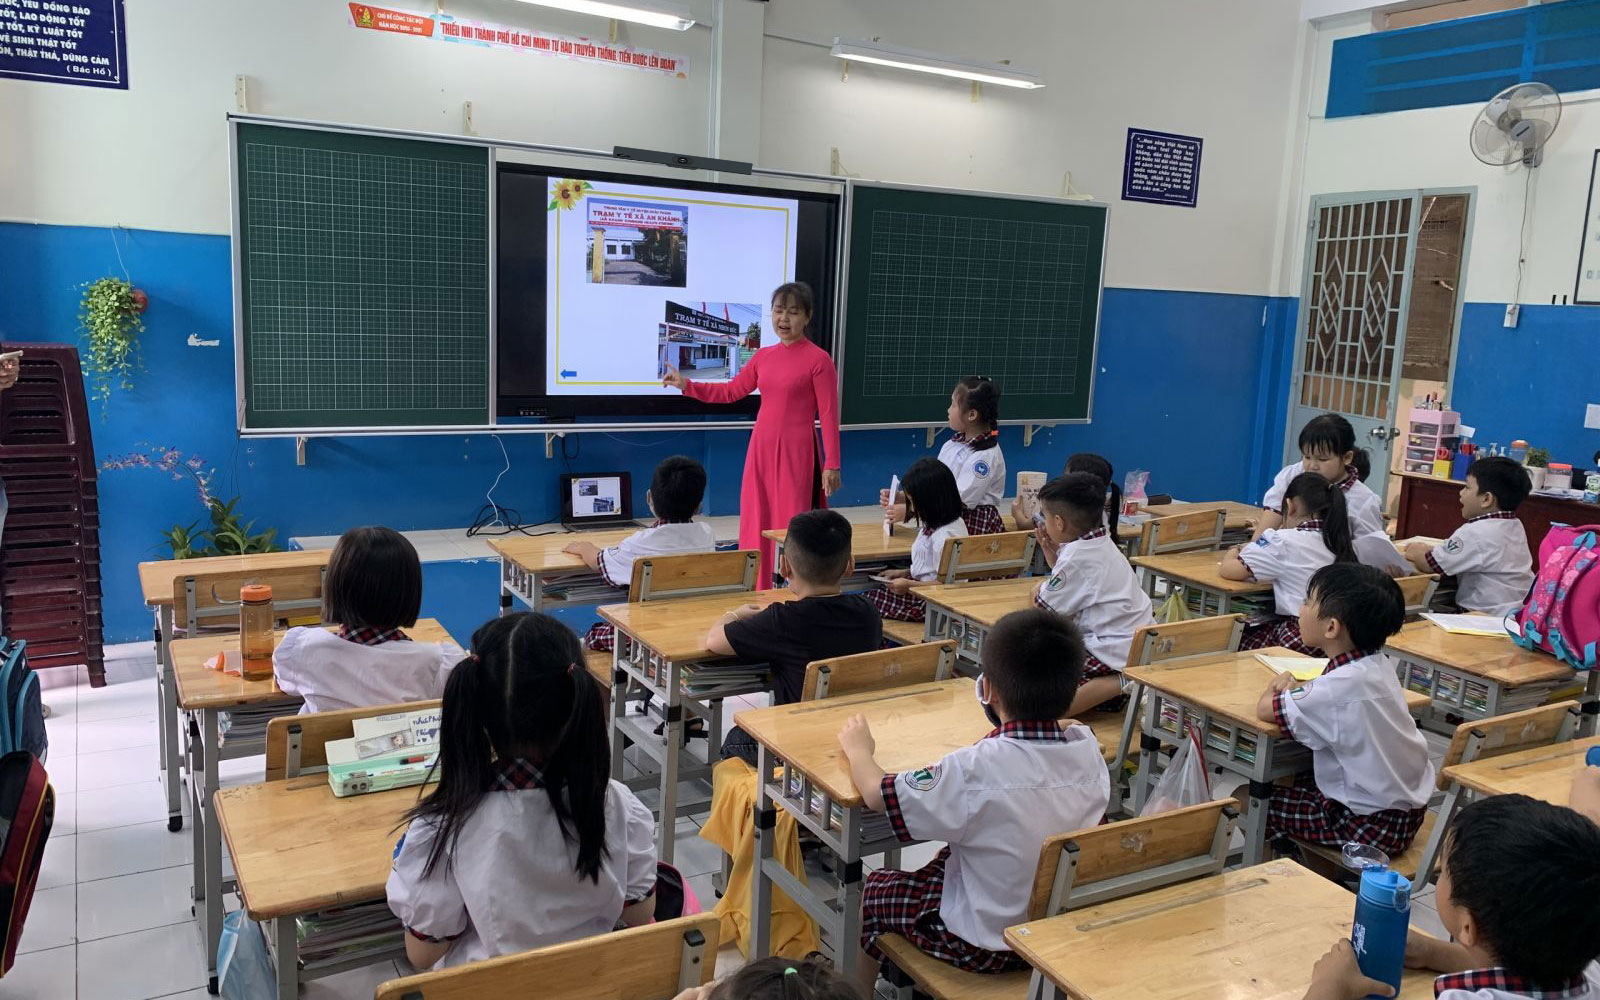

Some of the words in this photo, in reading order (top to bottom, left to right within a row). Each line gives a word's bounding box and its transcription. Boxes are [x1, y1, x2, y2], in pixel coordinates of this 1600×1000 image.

[73, 4, 90, 15] BÀO
[20, 12, 37, 20] LAO
[40, 13, 66, 24] ĐỘNG
[69, 16, 85, 27] TỐT
[43, 27, 64, 37] LUẬT
[66, 28, 83, 38] TỐT
[12, 37, 34, 45] SINH
[36, 38, 58, 48] THẬT
[60, 40, 77, 50] TỐT
[461, 26, 473, 38] NHI
[475, 26, 495, 42] THÀNH
[497, 29, 510, 44] PHỐ
[511, 30, 519, 45] HỒ
[521, 33, 532, 47] CHÍ
[533, 37, 550, 50] MINH
[560, 41, 573, 53] HÀO
[574, 43, 596, 58] TRUYỀN
[619, 49, 631, 63] TIẾN
[649, 54, 658, 67] LÊN
[16, 48, 38, 59] THẬT
[63, 53, 88, 63] DŨNG
[91, 54, 110, 65] CẢM
[593, 210, 614, 218] TRẠM
[675, 313, 695, 323] TRẠM
